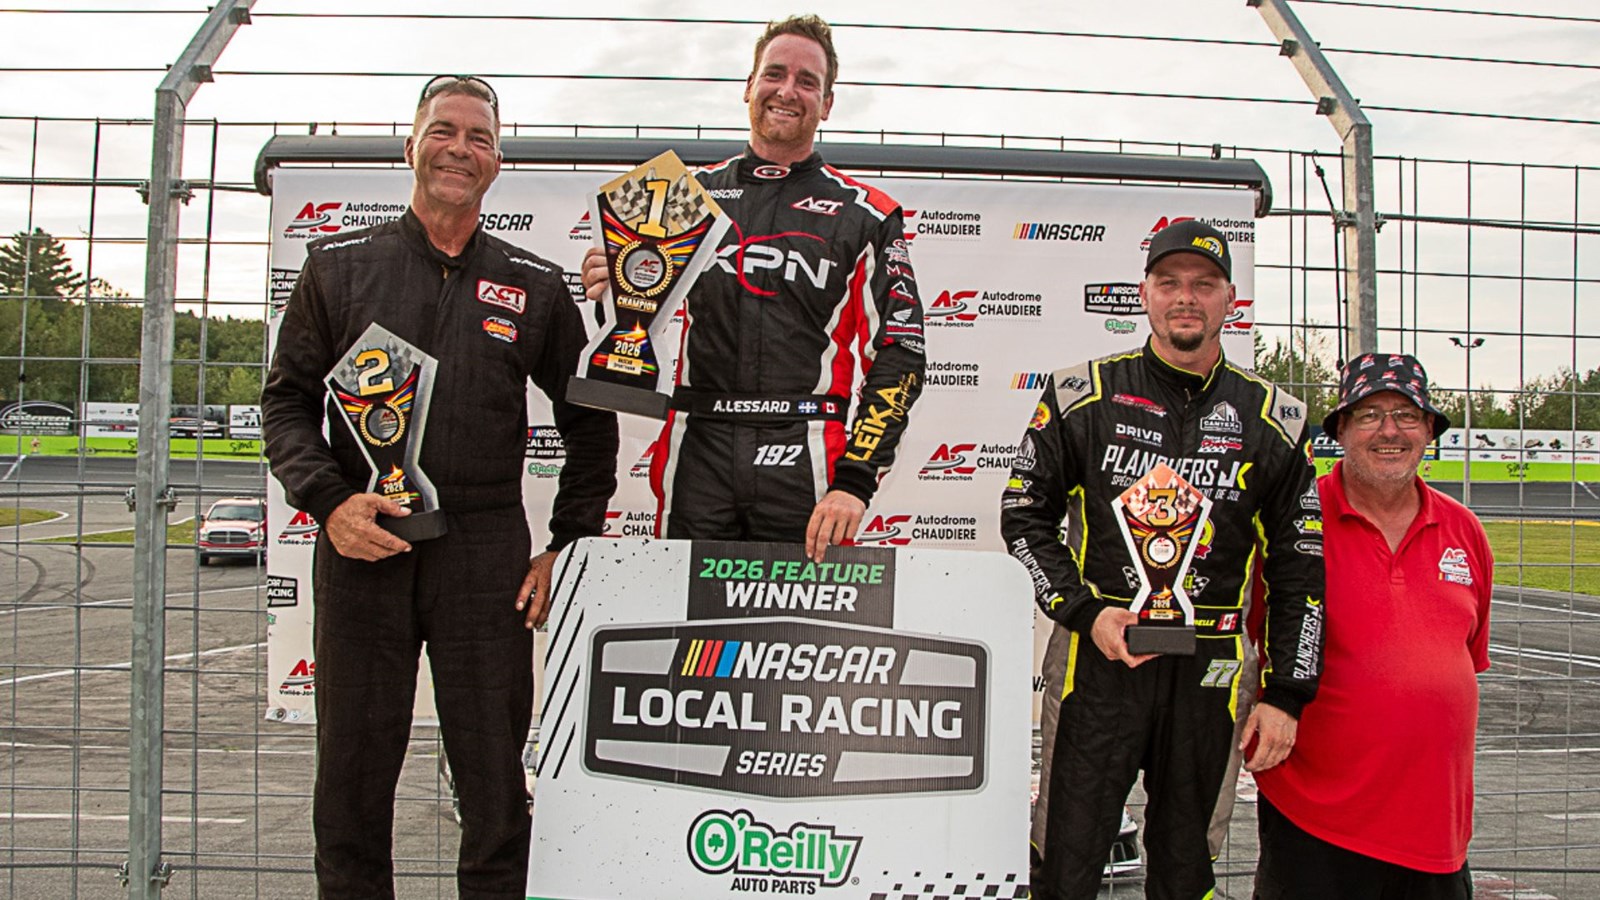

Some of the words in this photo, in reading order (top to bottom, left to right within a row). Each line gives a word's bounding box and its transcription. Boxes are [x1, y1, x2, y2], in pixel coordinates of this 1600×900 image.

[345, 202, 406, 213] Autodrome
[636, 178, 670, 239] 1
[920, 210, 981, 221] Autodrome
[917, 223, 981, 235] CHAUDIERE
[1034, 223, 1105, 241] NASCAR
[616, 295, 658, 312] CHAMPION
[981, 291, 1042, 301] Autodrome
[1089, 296, 1119, 304] LOCAL
[978, 304, 1042, 316] CHAUDIERE
[614, 339, 641, 358] 2026
[354, 348, 395, 397] 2
[926, 361, 979, 371] utodrome
[924, 374, 979, 386] HAUDIERE
[713, 400, 791, 413] A.LESSARD
[1115, 423, 1163, 443] DRIVR
[752, 445, 803, 467] 192
[1147, 488, 1178, 527] 3
[915, 515, 976, 525] Autodrome
[911, 528, 976, 540] CHAUDIERE
[700, 558, 764, 581] 2026
[769, 560, 886, 585] FEATURE
[725, 581, 859, 612] WINNER
[732, 639, 897, 685] NASCAR
[1200, 659, 1242, 688] 77
[612, 686, 768, 731] LOCAL
[780, 693, 963, 740] RACING
[736, 750, 828, 778] SERIES
[695, 817, 852, 879] O'Reilly
[730, 877, 768, 893] AUTO
[771, 878, 816, 895] PARTS
